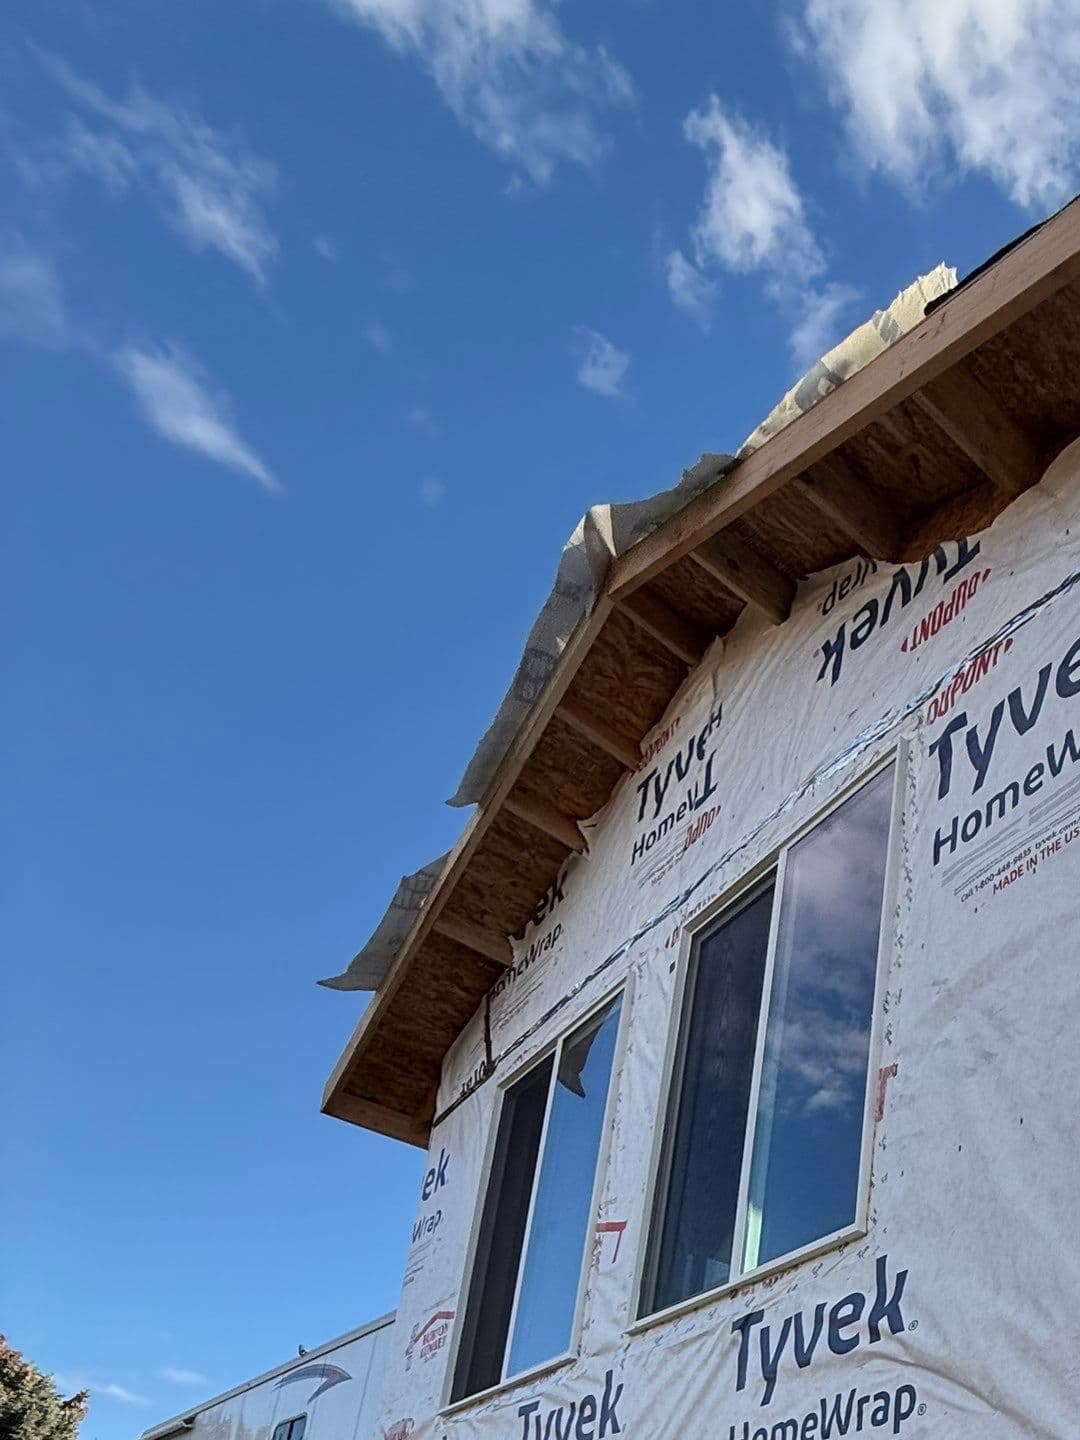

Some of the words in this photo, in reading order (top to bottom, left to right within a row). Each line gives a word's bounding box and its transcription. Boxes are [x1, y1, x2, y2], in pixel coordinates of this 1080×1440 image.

[909, 571, 980, 651] DUPONT
[993, 864, 1025, 895] MADE
[1026, 855, 1038, 872] IN
[1040, 839, 1062, 860] THE
[731, 1254, 909, 1407] Tyvek
